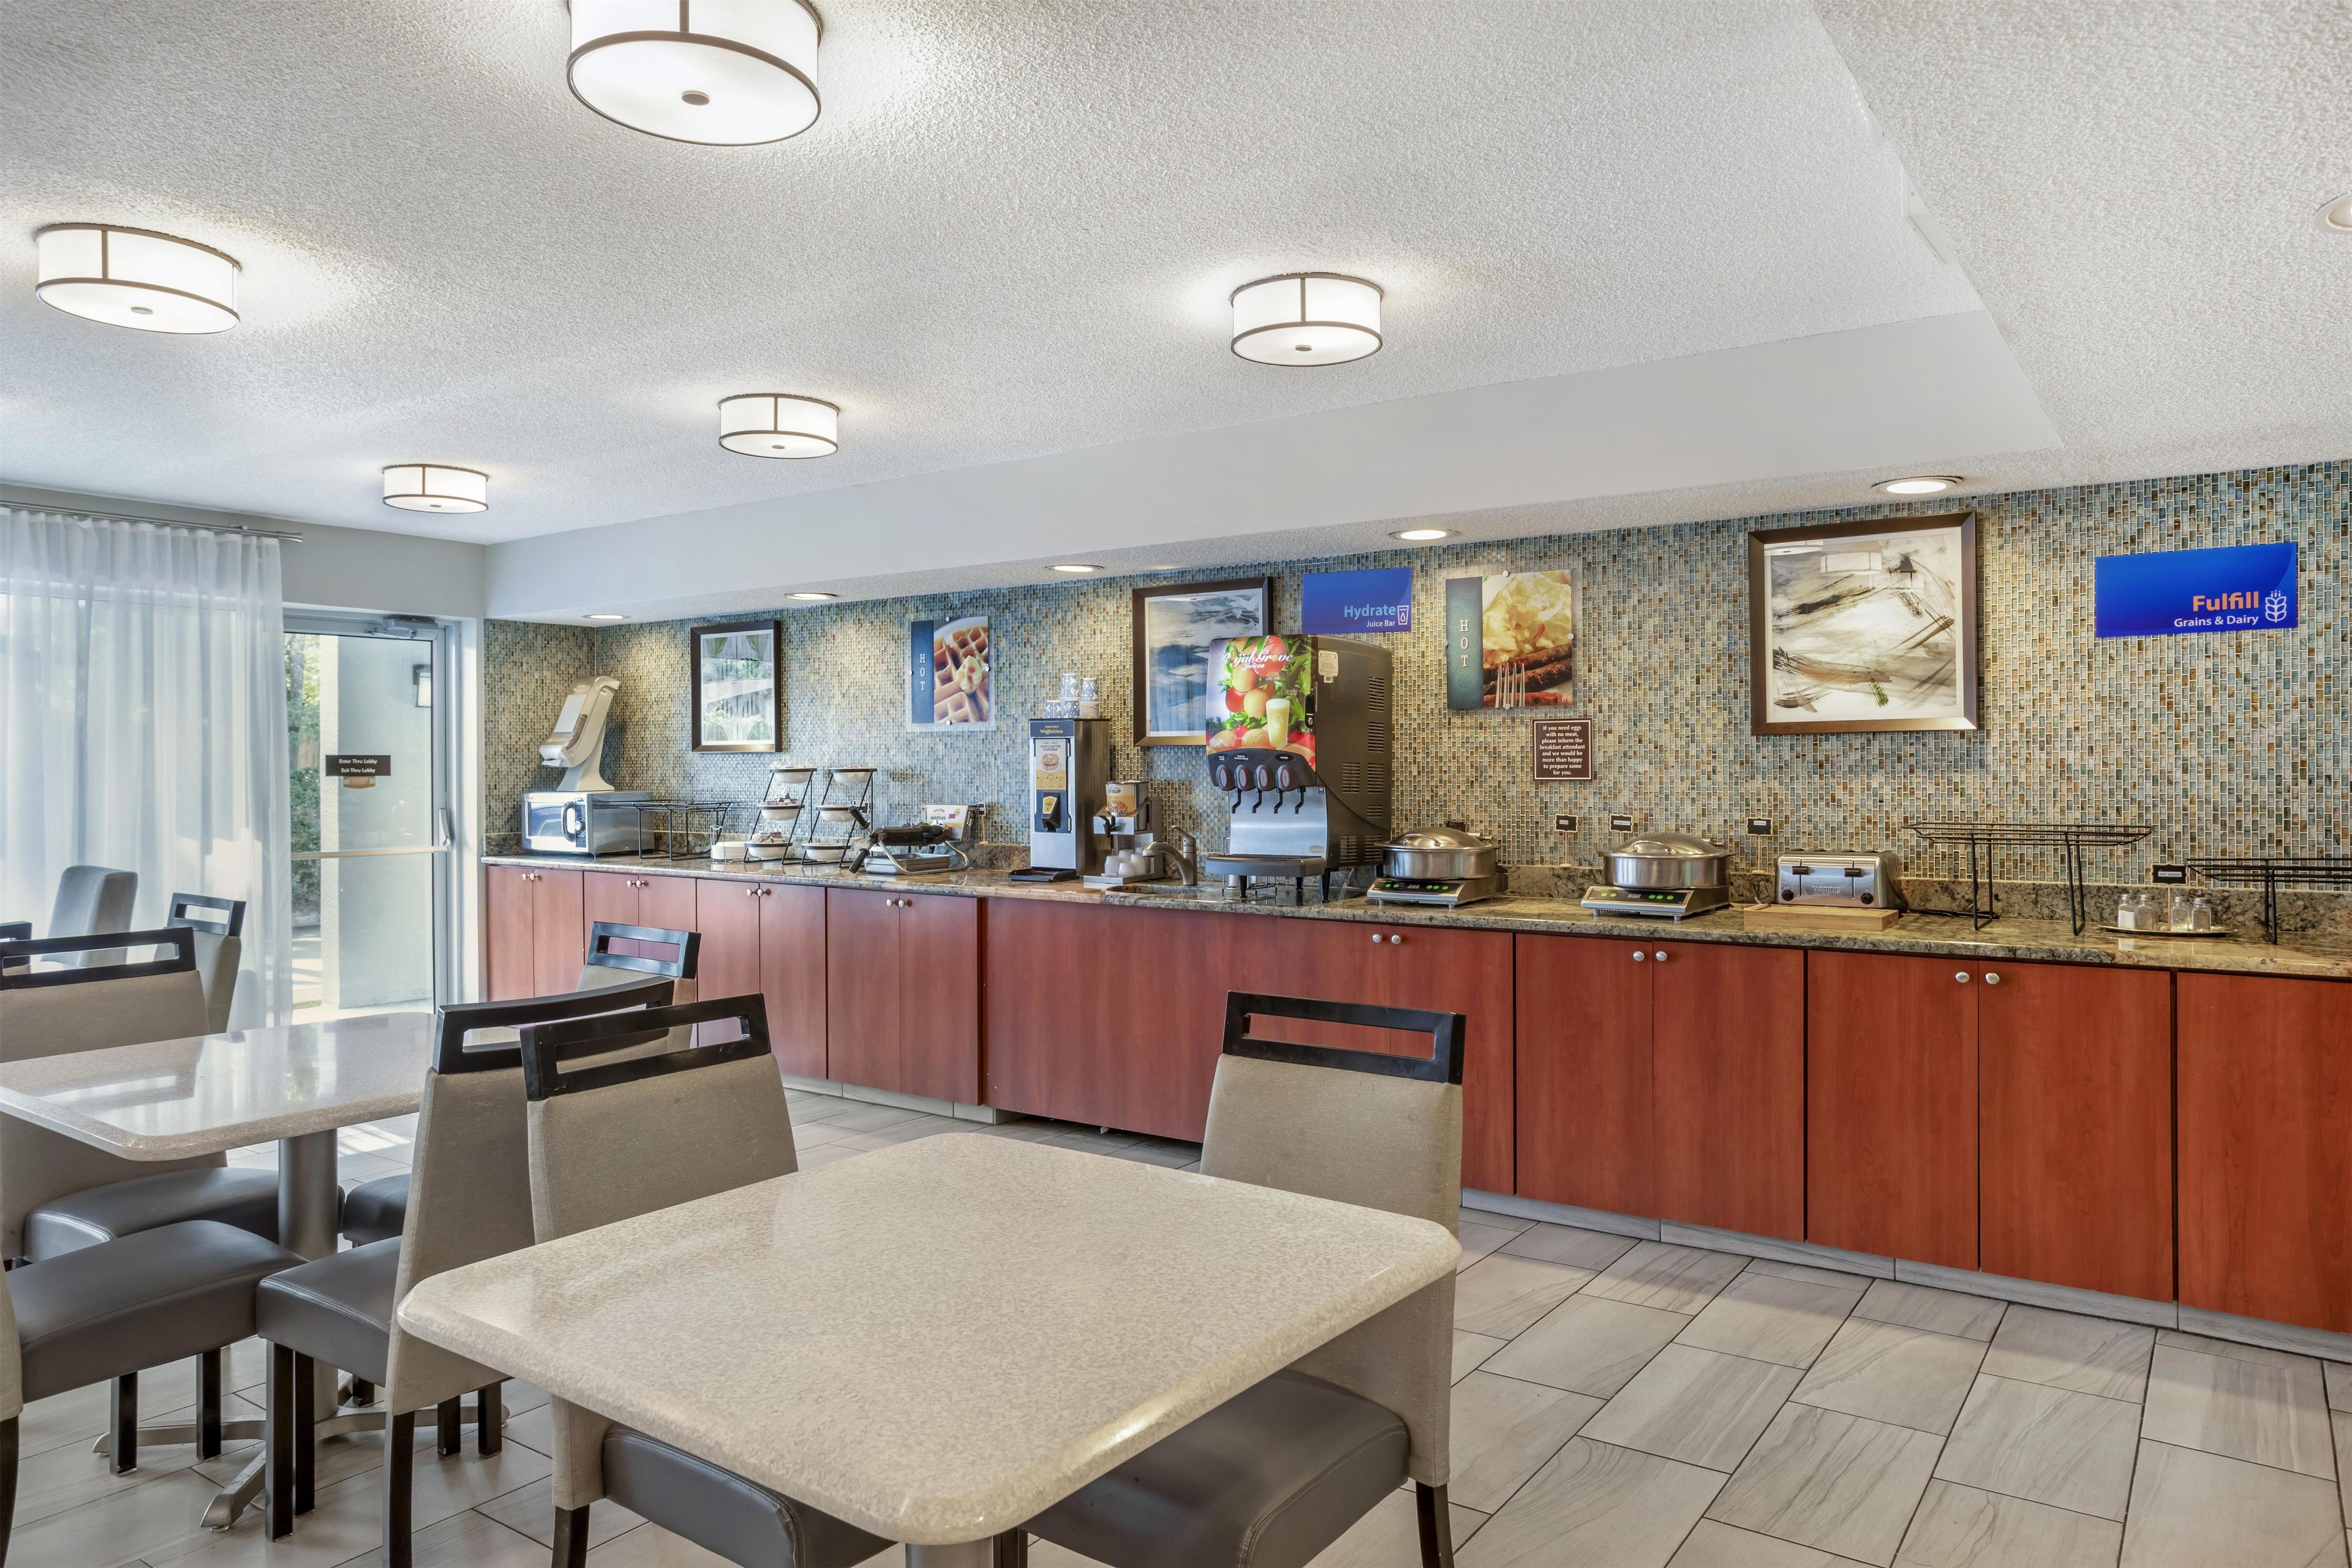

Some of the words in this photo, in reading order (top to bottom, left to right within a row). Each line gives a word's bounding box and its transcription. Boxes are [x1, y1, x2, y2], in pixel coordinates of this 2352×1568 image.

[2193, 591, 2259, 612] Fulfill
[1344, 604, 1396, 620] Hydrate
[2174, 618, 2211, 627] Grains
[2215, 616, 2223, 625] &
[2227, 615, 2259, 626] Dairy
[1460, 620, 1469, 667] HOT
[1256, 650, 1294, 662] Grove
